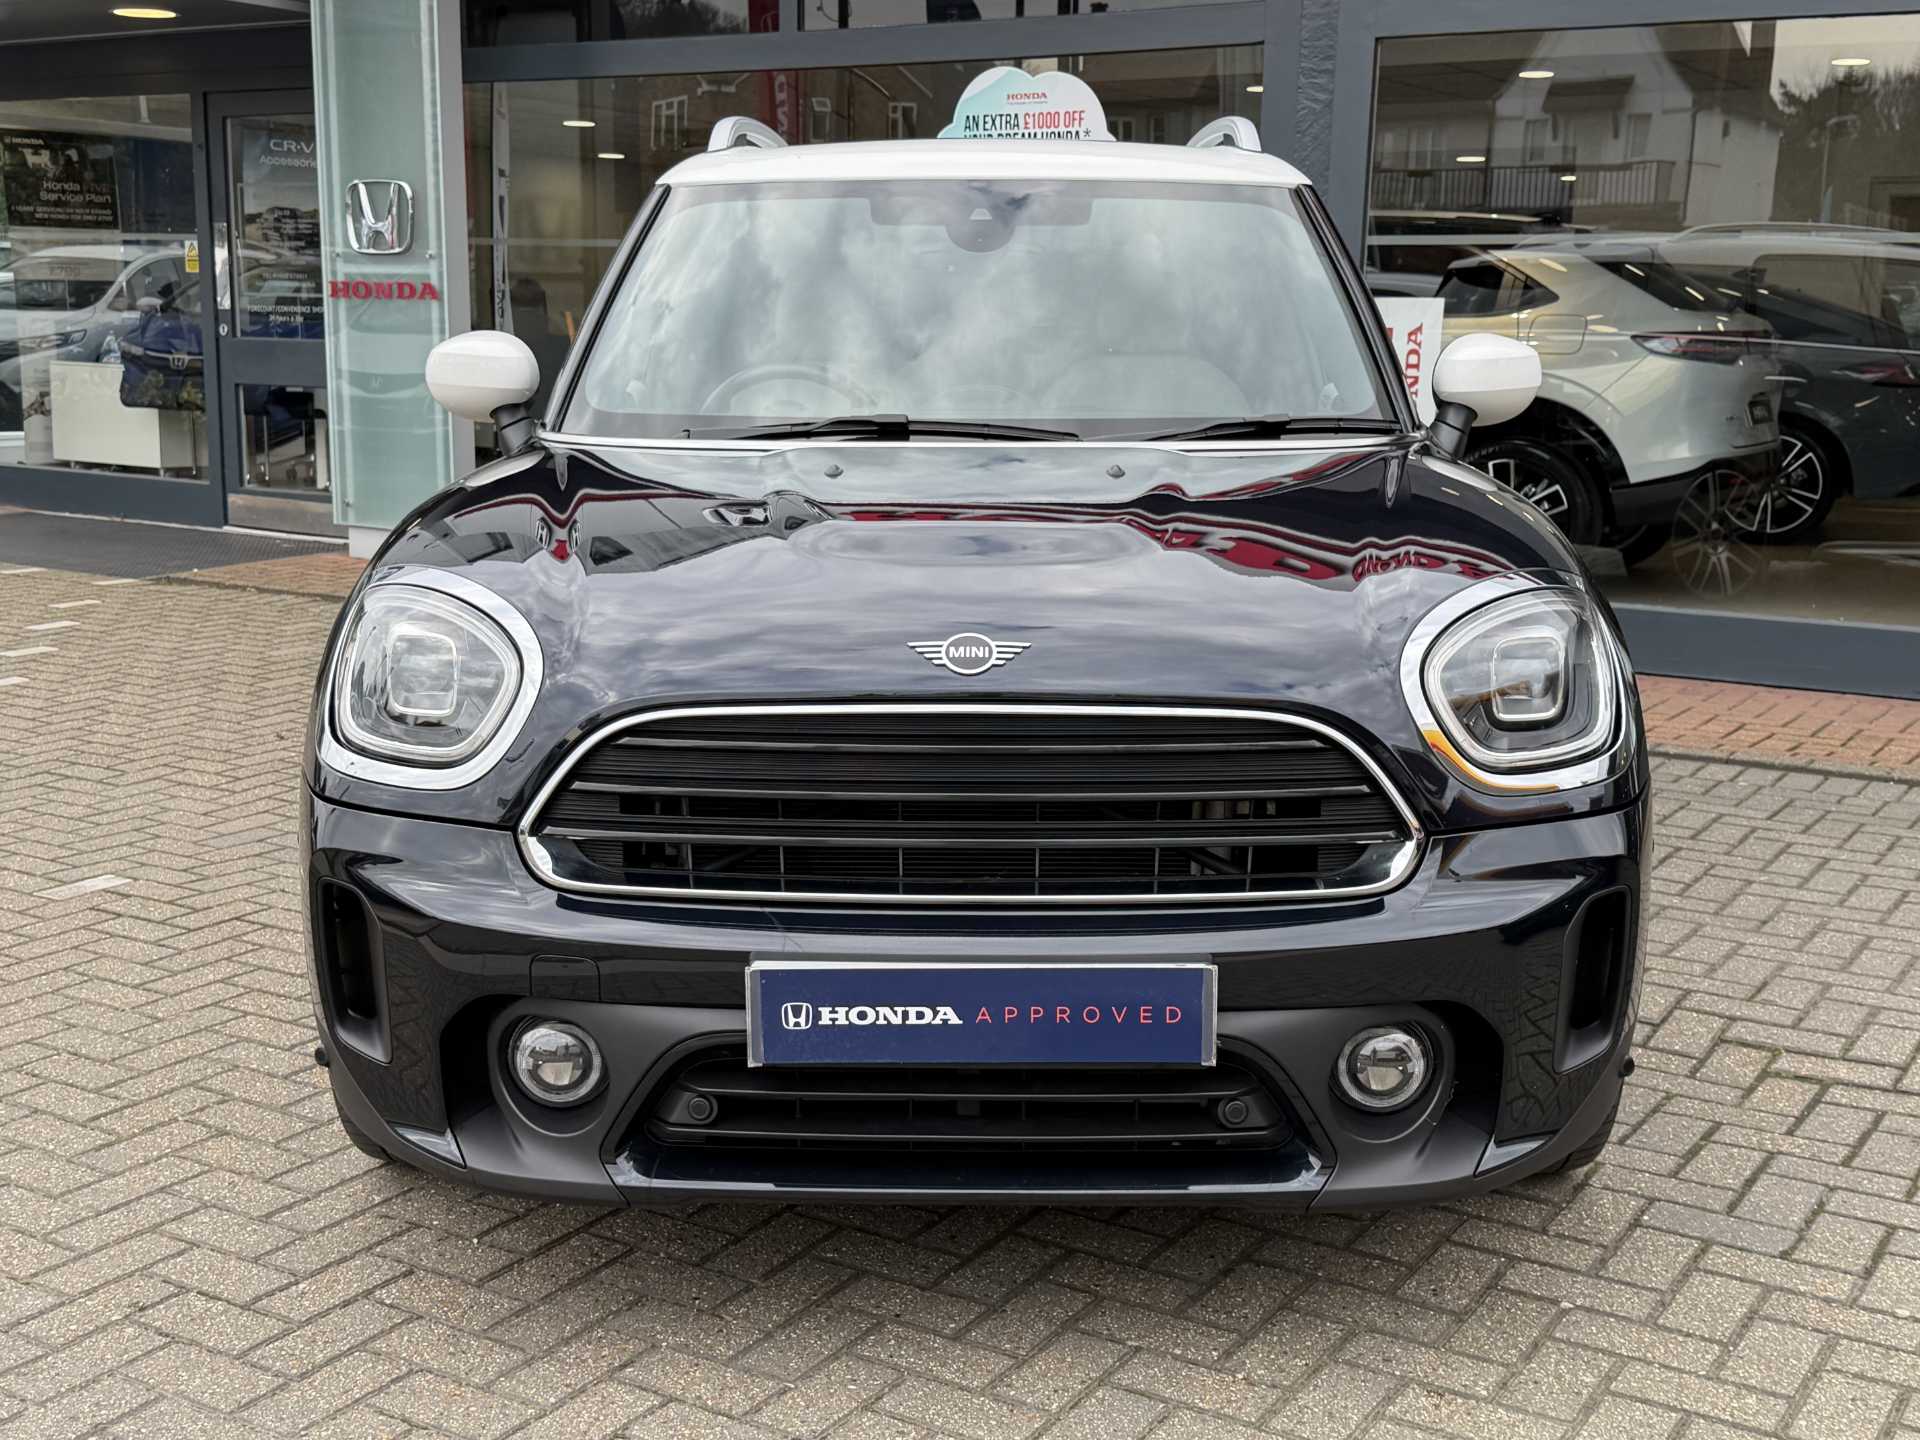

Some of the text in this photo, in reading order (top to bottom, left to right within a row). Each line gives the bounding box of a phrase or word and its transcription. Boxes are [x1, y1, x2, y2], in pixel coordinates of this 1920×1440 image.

[1007, 92, 1047, 100] HONDA
[964, 110, 1086, 132] AN EXTRA £1000 OFF
[43, 181, 80, 191] Honda
[40, 191, 111, 204] Service Plan
[328, 280, 440, 300] HONDA
[1405, 322, 1424, 398] NDA
[949, 646, 989, 658] MINI
[818, 1006, 963, 1025] HONDA
[975, 1006, 1183, 1024] APPROVED
